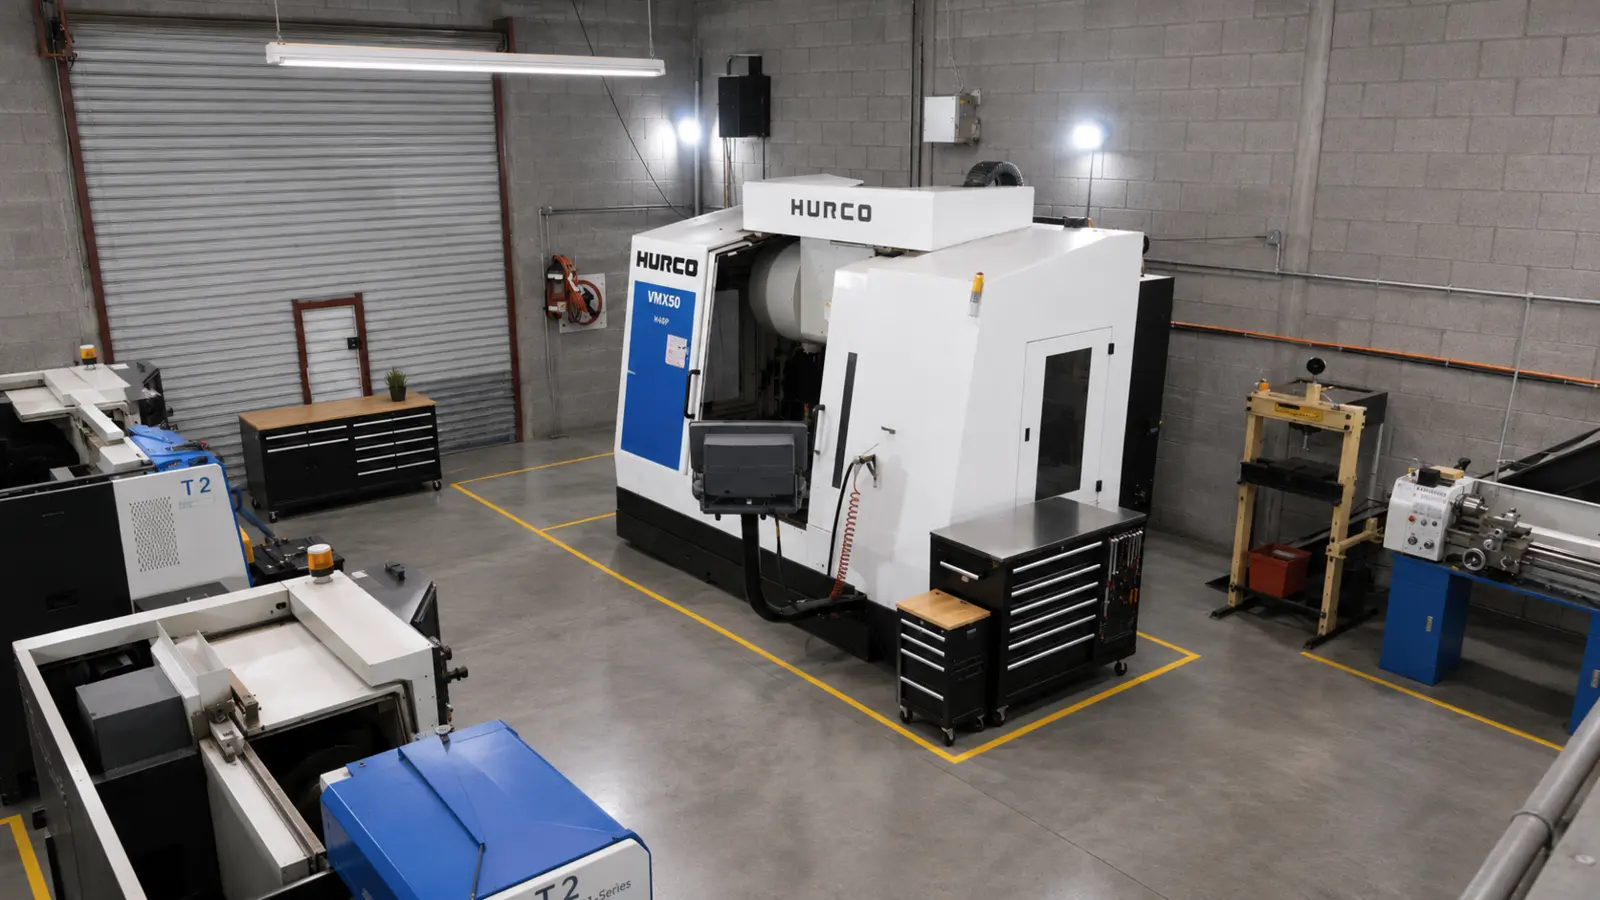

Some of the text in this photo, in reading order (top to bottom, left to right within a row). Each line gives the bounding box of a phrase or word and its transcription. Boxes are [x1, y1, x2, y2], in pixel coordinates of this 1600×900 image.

[791, 198, 872, 222] HURCO
[636, 250, 699, 277] HURCO
[647, 290, 681, 309] VMX50
